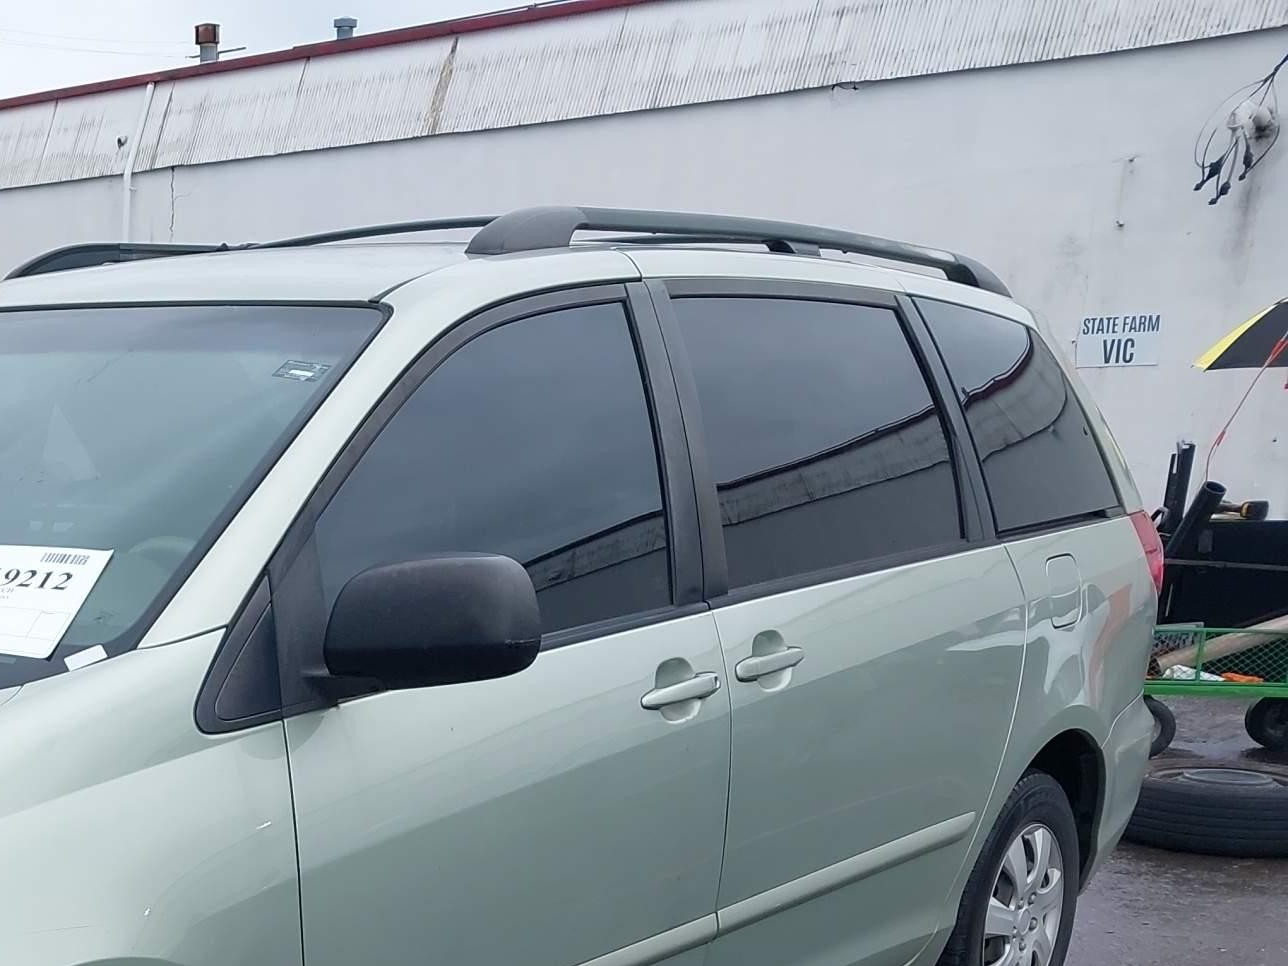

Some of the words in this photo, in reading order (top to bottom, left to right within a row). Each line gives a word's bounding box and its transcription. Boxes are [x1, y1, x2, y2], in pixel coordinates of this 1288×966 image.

[1082, 316, 1119, 335] STATE
[1122, 314, 1161, 333] FARM
[1102, 338, 1136, 364] VIC
